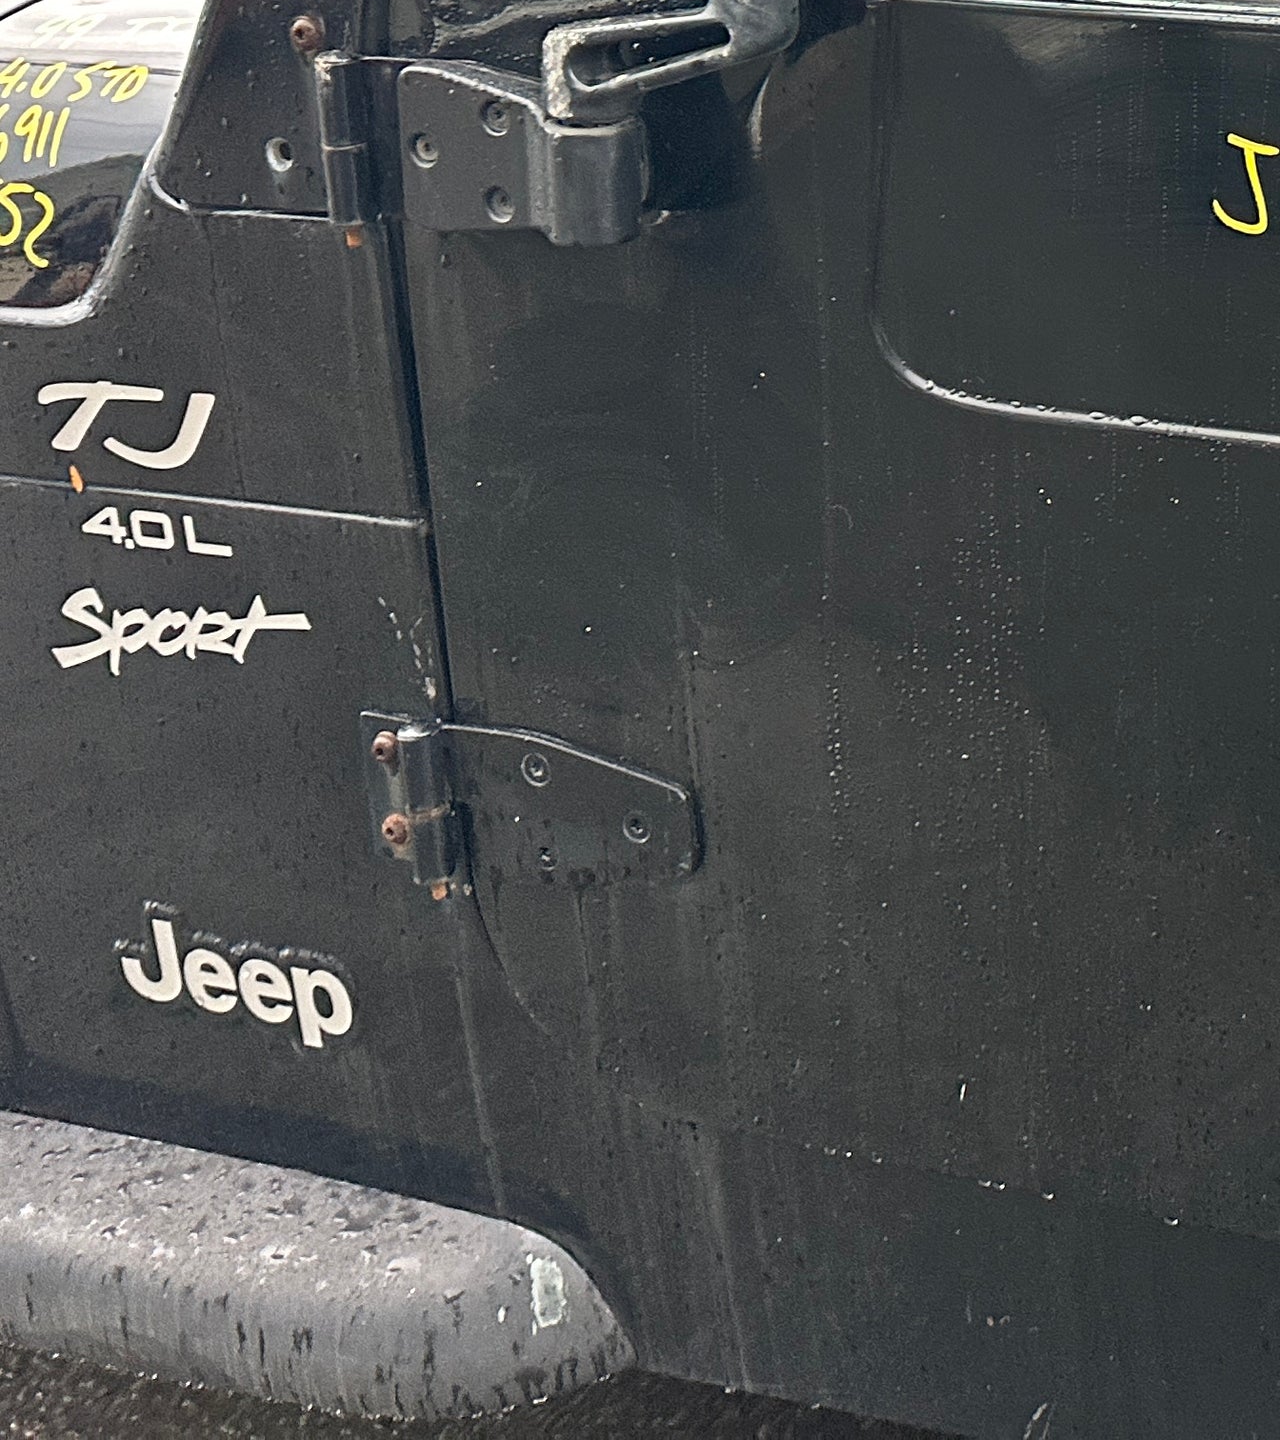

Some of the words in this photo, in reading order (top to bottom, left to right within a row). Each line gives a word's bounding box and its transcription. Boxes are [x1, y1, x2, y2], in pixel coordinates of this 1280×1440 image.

[30, 14, 108, 50] 99
[0, 57, 68, 99] 4.0
[68, 61, 149, 103] STD
[0, 173, 56, 268] 52
[38, 381, 216, 470] TJ
[121, 918, 353, 1048] Jeep
